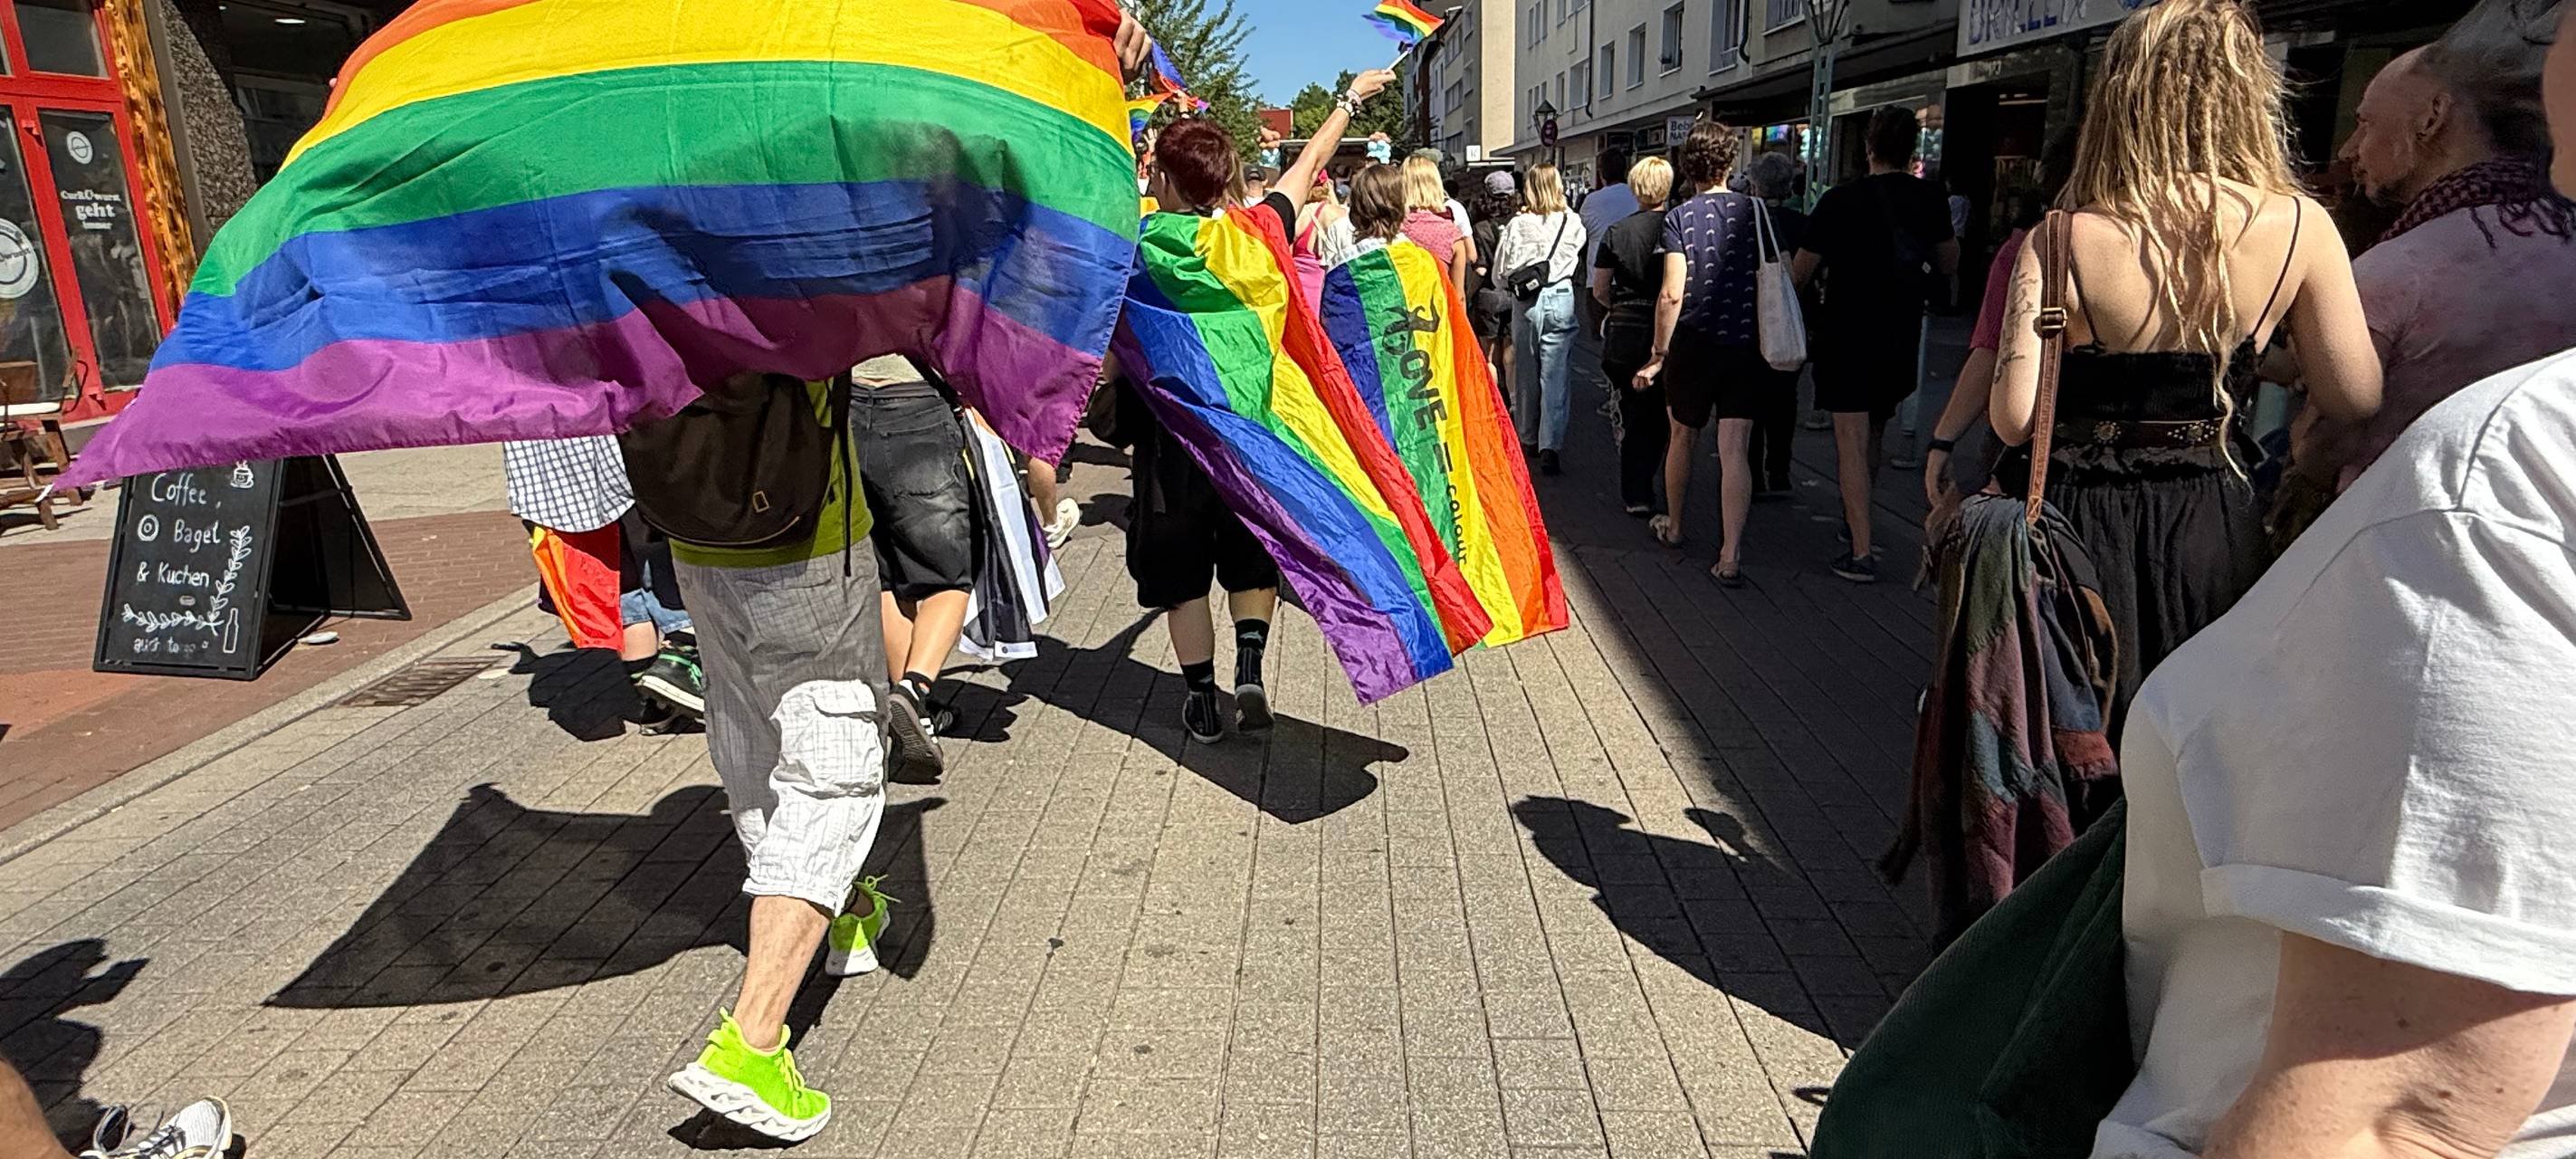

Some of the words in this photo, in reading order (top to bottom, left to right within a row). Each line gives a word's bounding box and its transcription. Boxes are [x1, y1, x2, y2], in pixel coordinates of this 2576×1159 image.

[75, 202, 116, 220] geht
[173, 519, 221, 553] Bagel
[1445, 484, 1467, 565] colour
[137, 561, 149, 583] &
[157, 563, 210, 588] Kuchen
